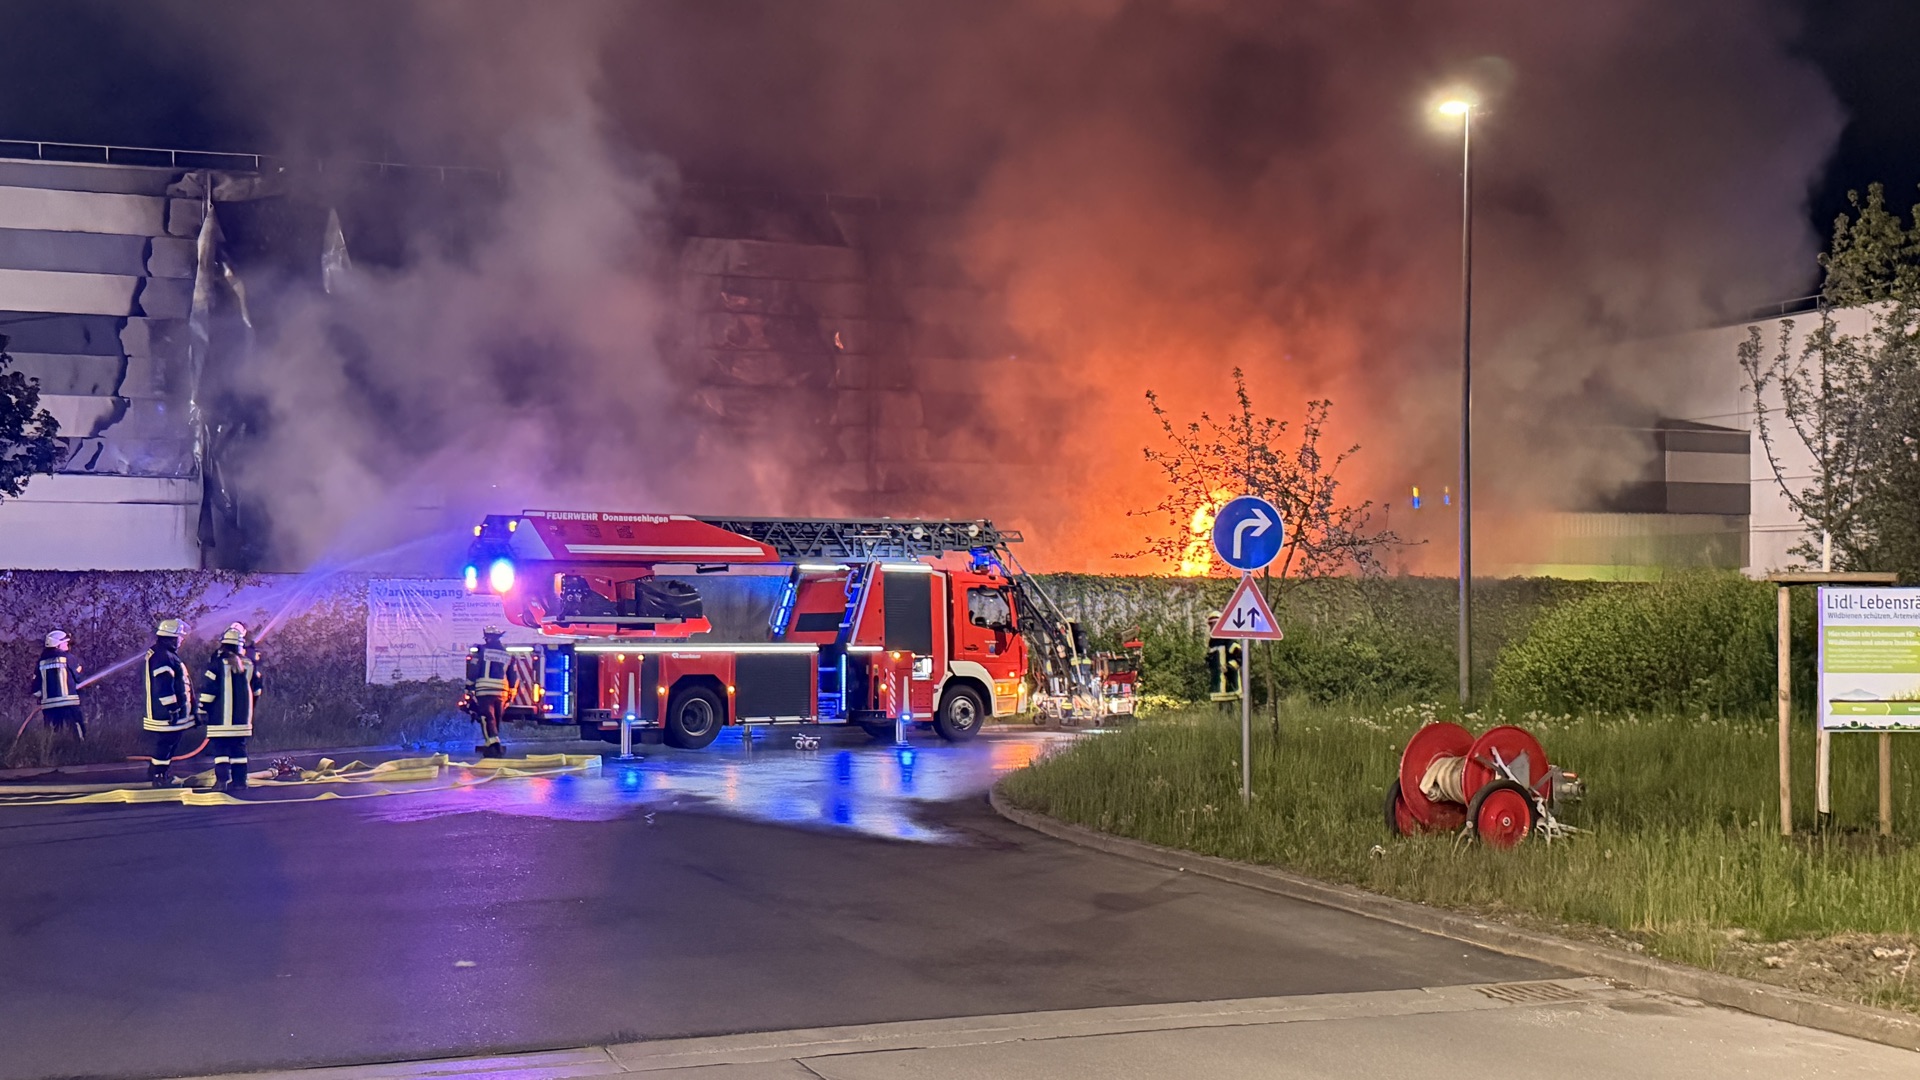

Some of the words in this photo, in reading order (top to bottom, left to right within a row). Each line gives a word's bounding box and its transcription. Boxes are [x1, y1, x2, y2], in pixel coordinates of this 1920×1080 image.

[547, 512, 598, 521] FEUERWEHR
[603, 513, 668, 524] Donaueschingen
[1864, 612, 1892, 620] schützen,
